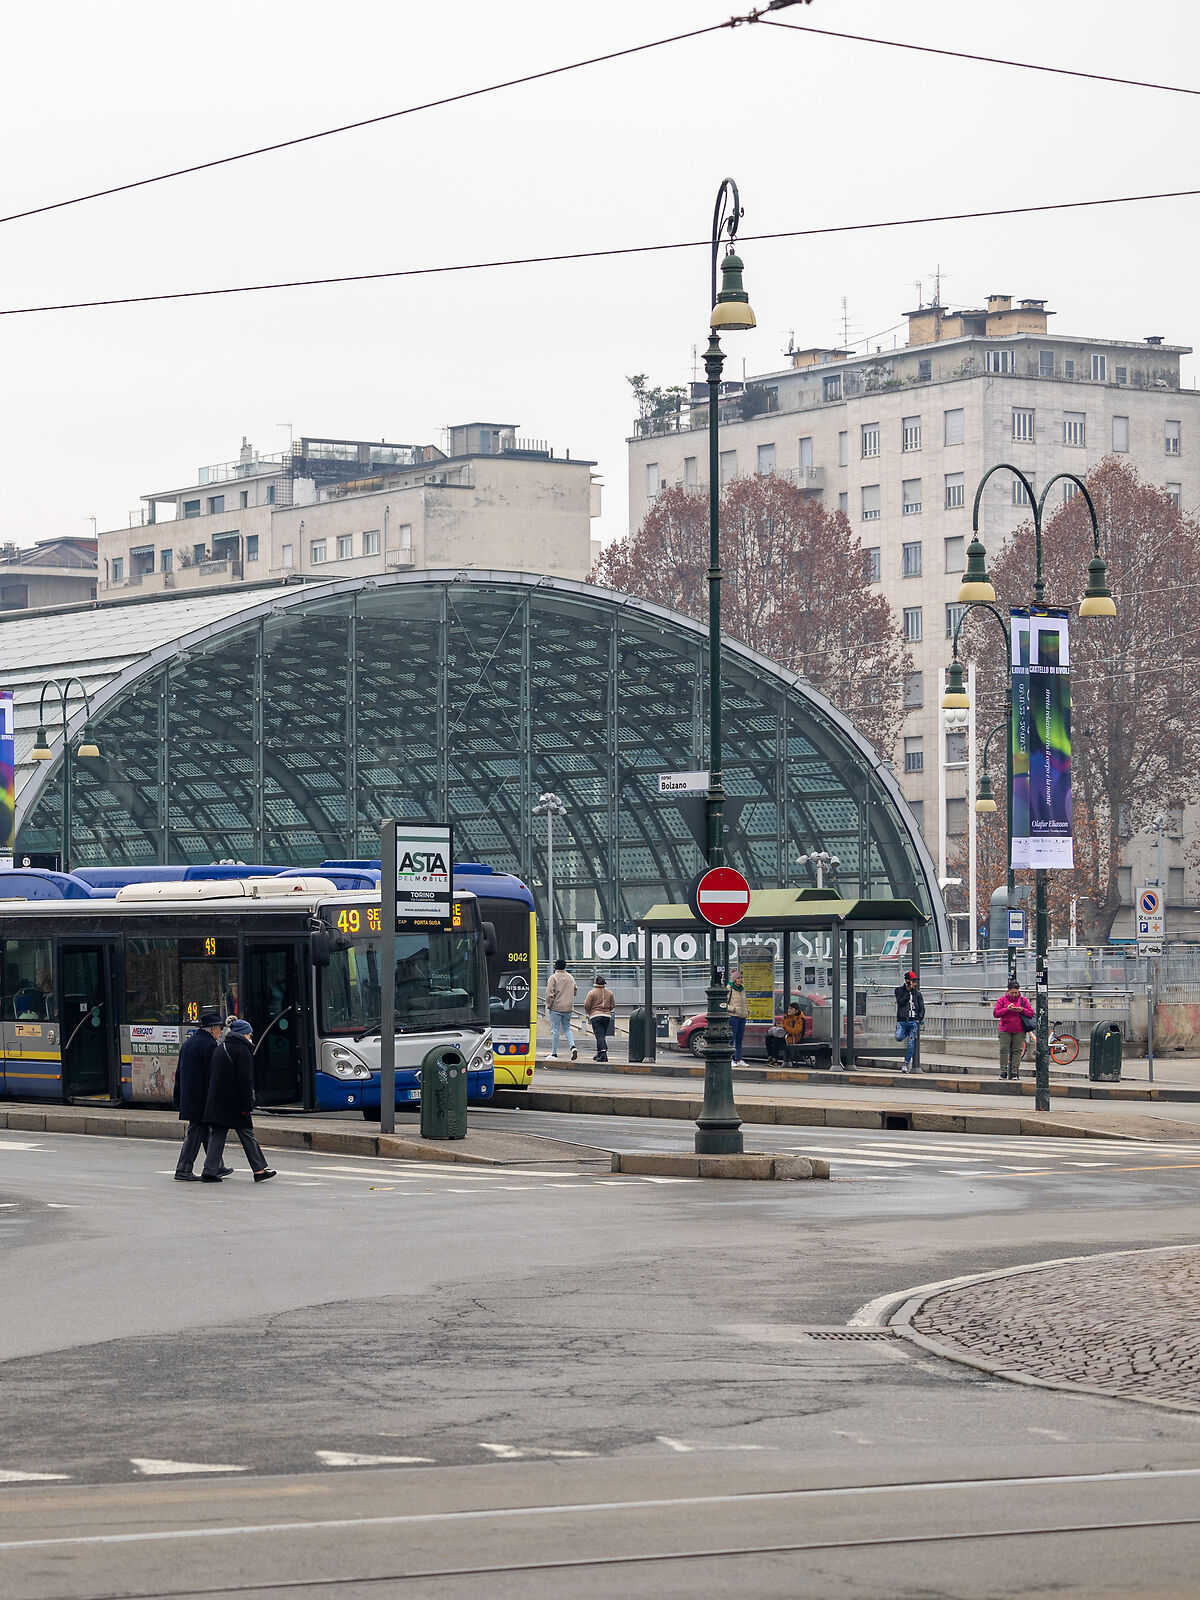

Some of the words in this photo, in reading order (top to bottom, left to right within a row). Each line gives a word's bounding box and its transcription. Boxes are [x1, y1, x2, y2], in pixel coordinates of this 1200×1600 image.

[1029, 665, 1049, 674] CASTELLO
[1049, 666, 1056, 674] DI
[1044, 755, 1052, 774] corpo
[661, 782, 687, 790] Bolzano
[1031, 819, 1048, 829] Olafur
[398, 851, 448, 873] ASTA
[410, 891, 435, 899] TORINO
[337, 909, 360, 933] 49
[1140, 923, 1148, 932] P
[205, 936, 217, 955] 49
[576, 922, 698, 961] Torino
[508, 952, 529, 962] 9042
[187, 1001, 198, 1021] 49
